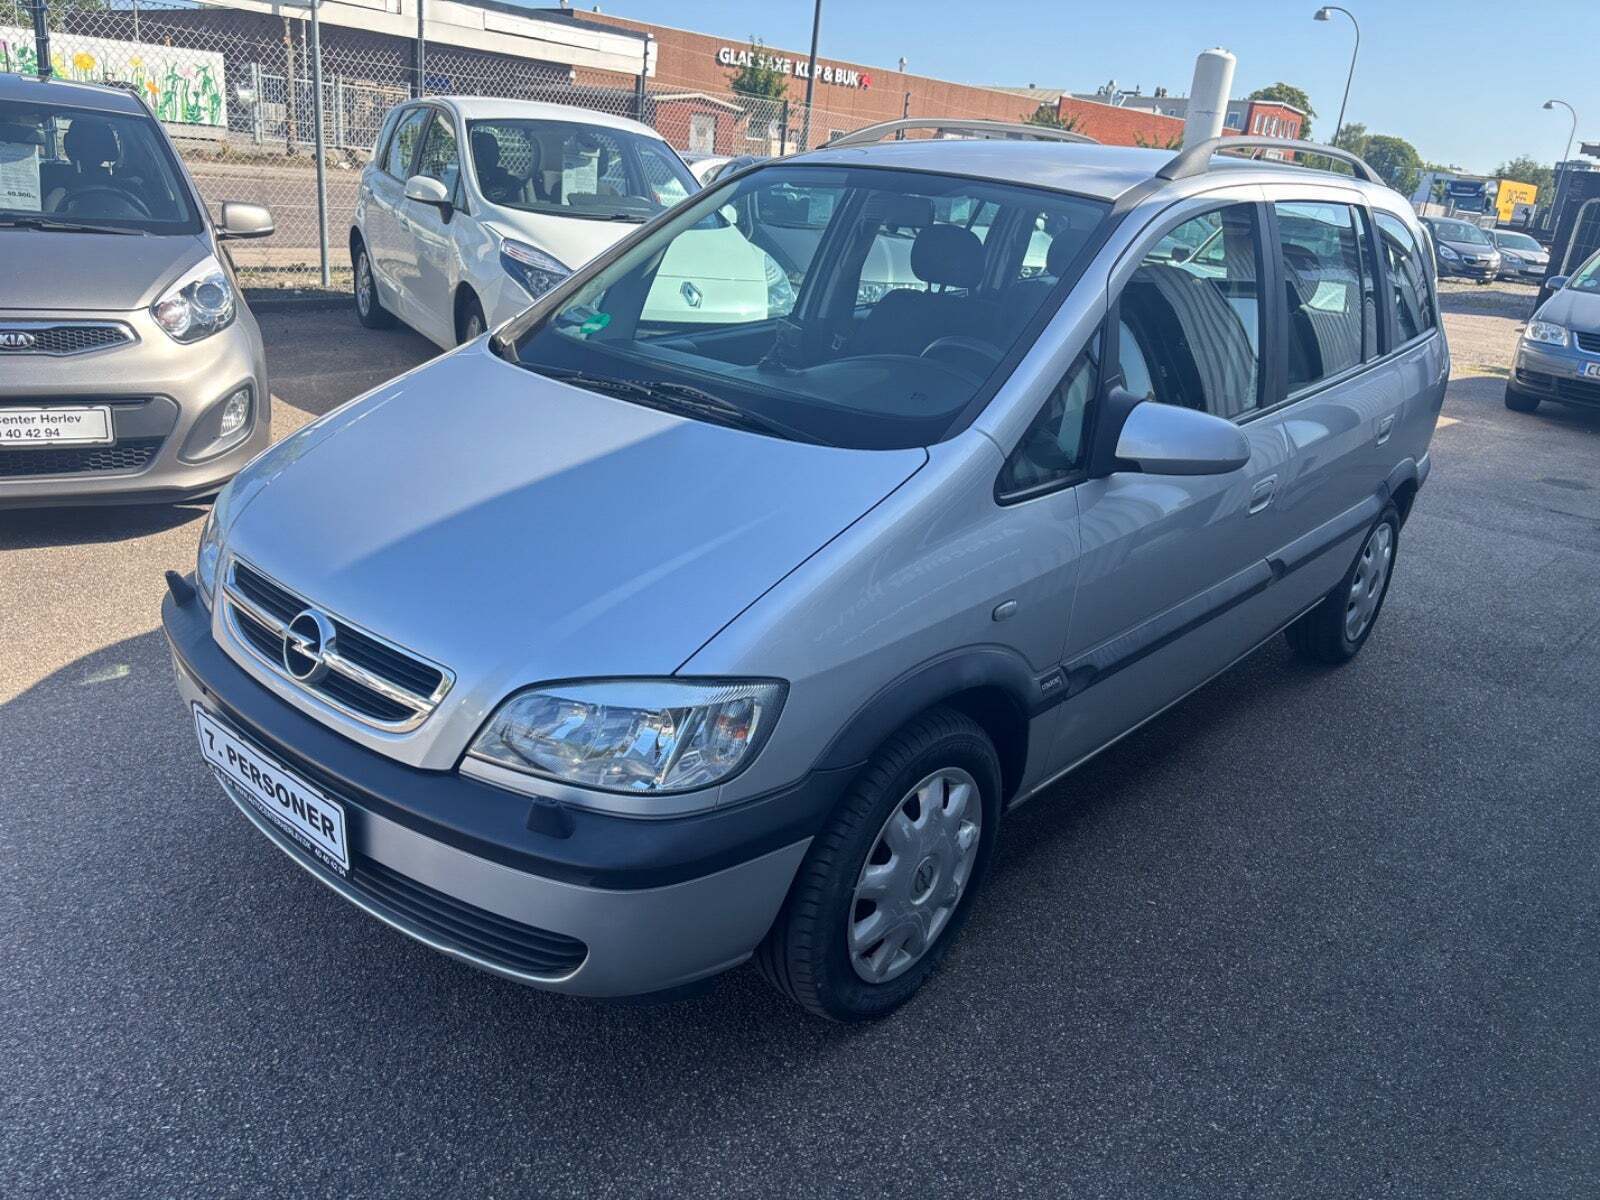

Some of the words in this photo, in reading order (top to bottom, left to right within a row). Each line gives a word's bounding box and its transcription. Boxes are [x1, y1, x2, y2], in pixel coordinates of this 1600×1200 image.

[795, 60, 823, 79] KLP
[823, 66, 833, 82] &
[835, 68, 860, 87] BUK
[0, 415, 36, 425] enter
[40, 413, 82, 424] Herlev
[6, 428, 21, 438] 40
[25, 428, 41, 438] 42
[45, 427, 60, 437] 94
[226, 743, 338, 844] PERSONER
